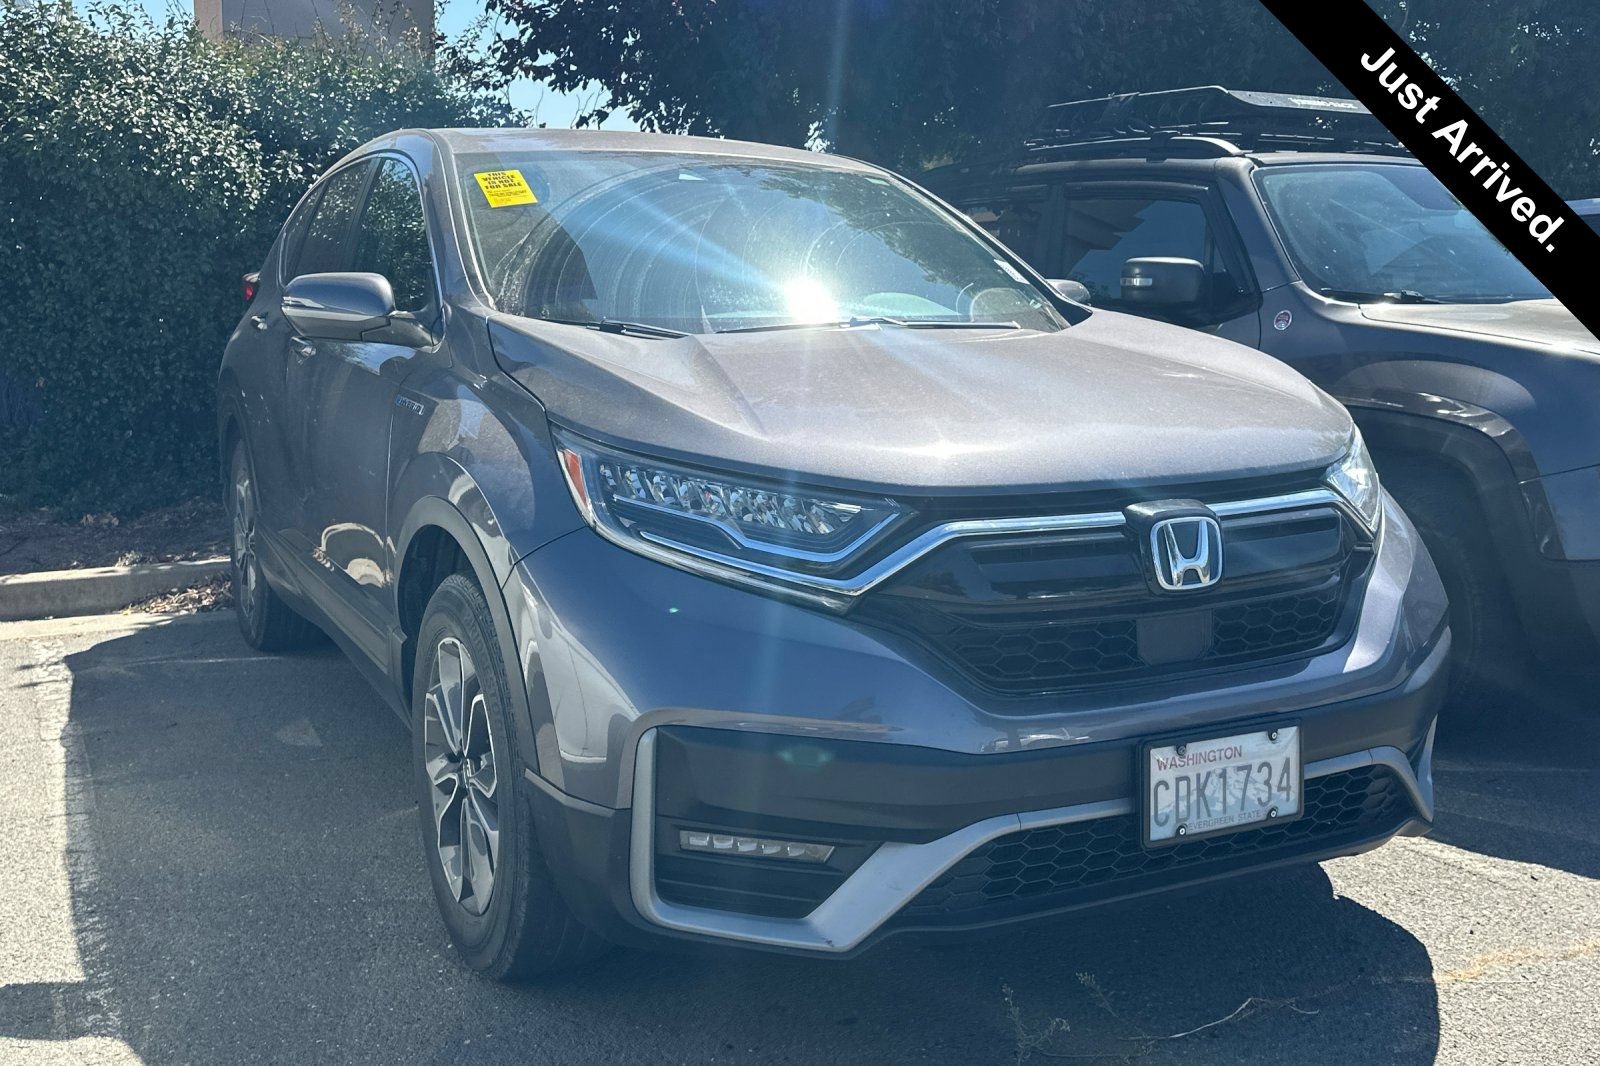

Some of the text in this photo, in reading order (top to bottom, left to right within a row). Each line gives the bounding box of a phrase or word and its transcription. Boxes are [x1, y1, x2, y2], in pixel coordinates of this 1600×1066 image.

[1156, 745, 1243, 772] WASHINGTON
[1153, 757, 1292, 827] CDK1734
[1189, 810, 1262, 831] EVERGREEN STATE
